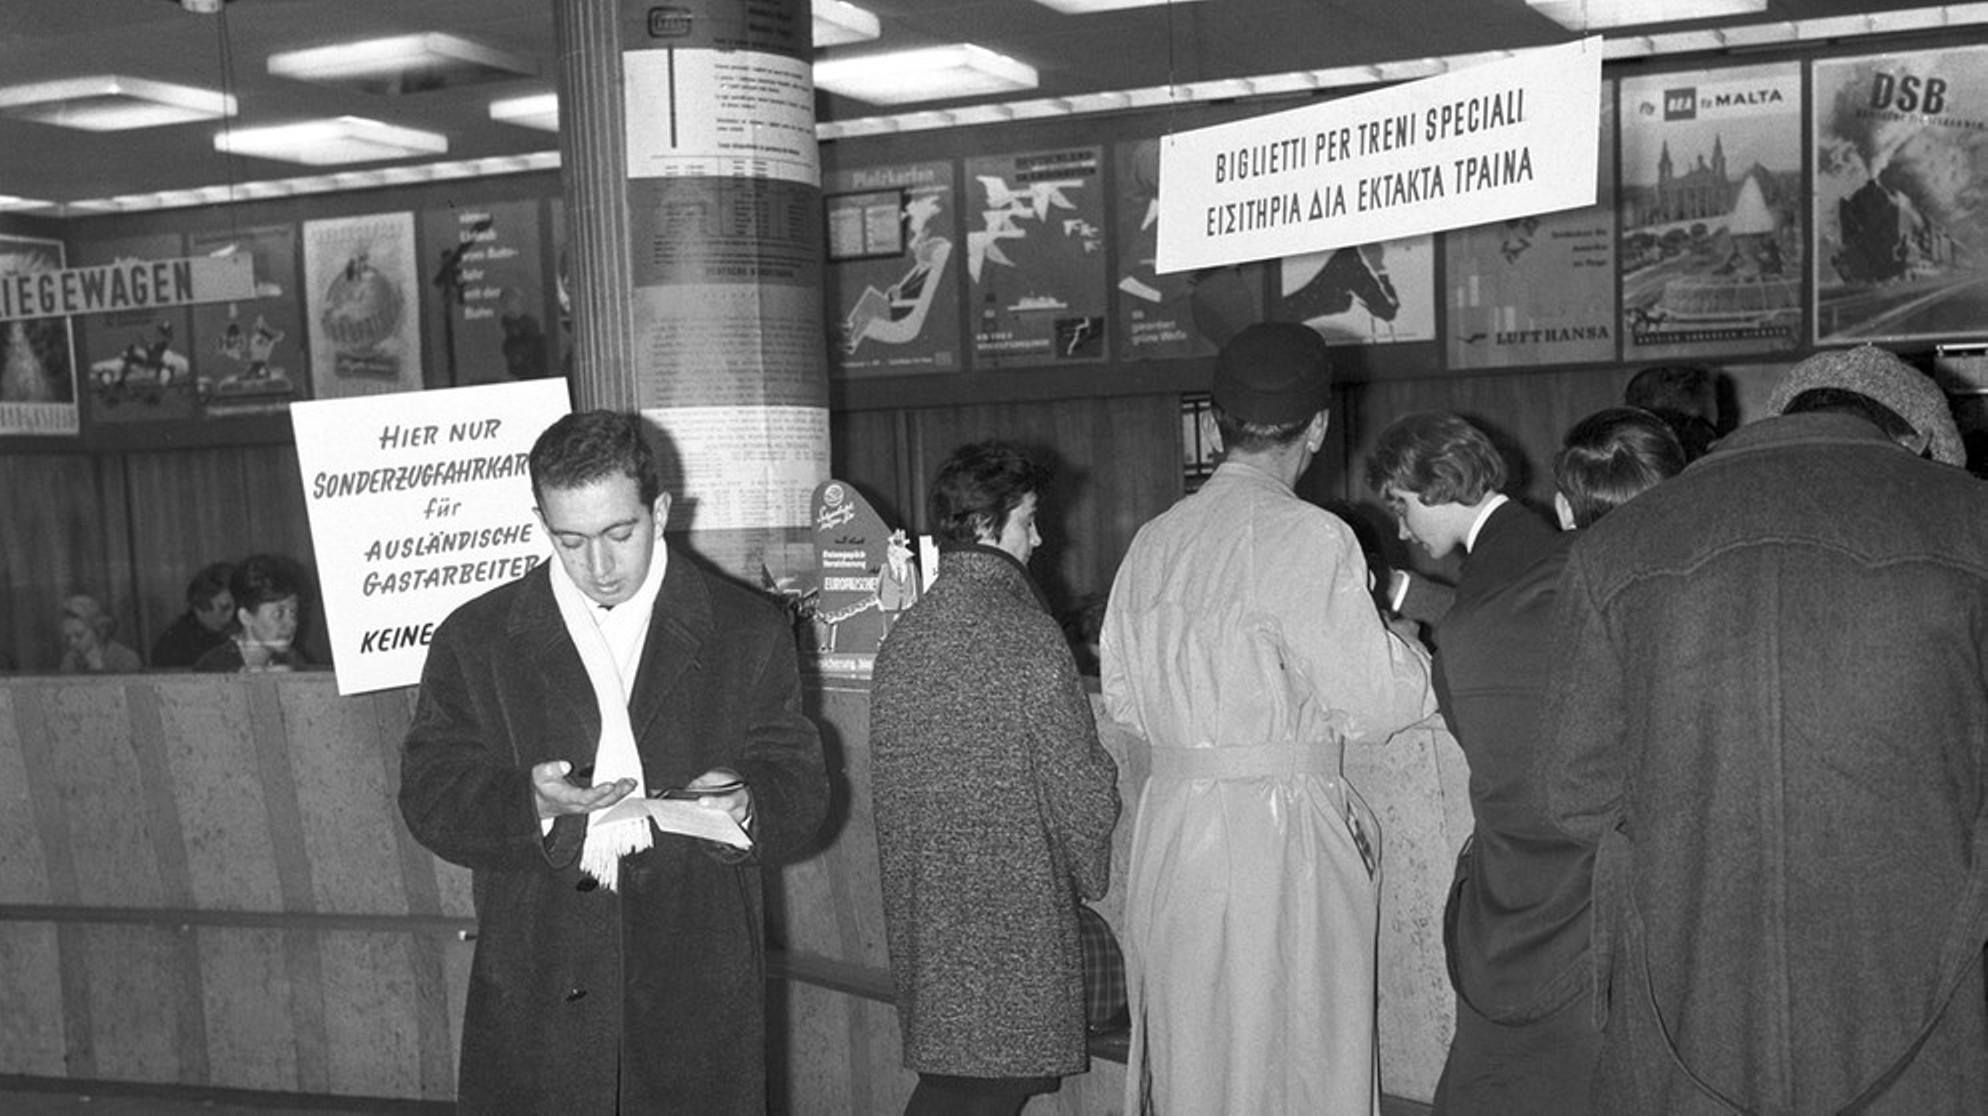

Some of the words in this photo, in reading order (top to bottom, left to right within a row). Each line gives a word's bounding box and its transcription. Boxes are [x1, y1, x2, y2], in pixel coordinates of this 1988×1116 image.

[1715, 89, 1783, 107] MALTA
[1870, 72, 1947, 114] DSB
[1216, 136, 1307, 184] BIGLIETTI
[1315, 127, 1351, 165] PER
[1358, 112, 1416, 157] TRENI
[1425, 88, 1524, 142] SPECIALI
[1206, 192, 1302, 237] ΕΙΣΙΤΗΡΙΑ
[1308, 184, 1347, 221] ΔΙΑ
[1358, 165, 1445, 213] ΕΚΤΑΚΤΑ
[1454, 146, 1534, 195] ΤΡΑΙΝΑ
[0, 260, 194, 318] IEGEWAGEN
[1496, 326, 1609, 345] LUFTHANSA
[379, 424, 439, 450] HIER
[449, 418, 501, 442] NUR
[423, 497, 462, 519] für
[364, 523, 533, 562] AUSLÄNDISCHE
[360, 622, 434, 654] KEINE
